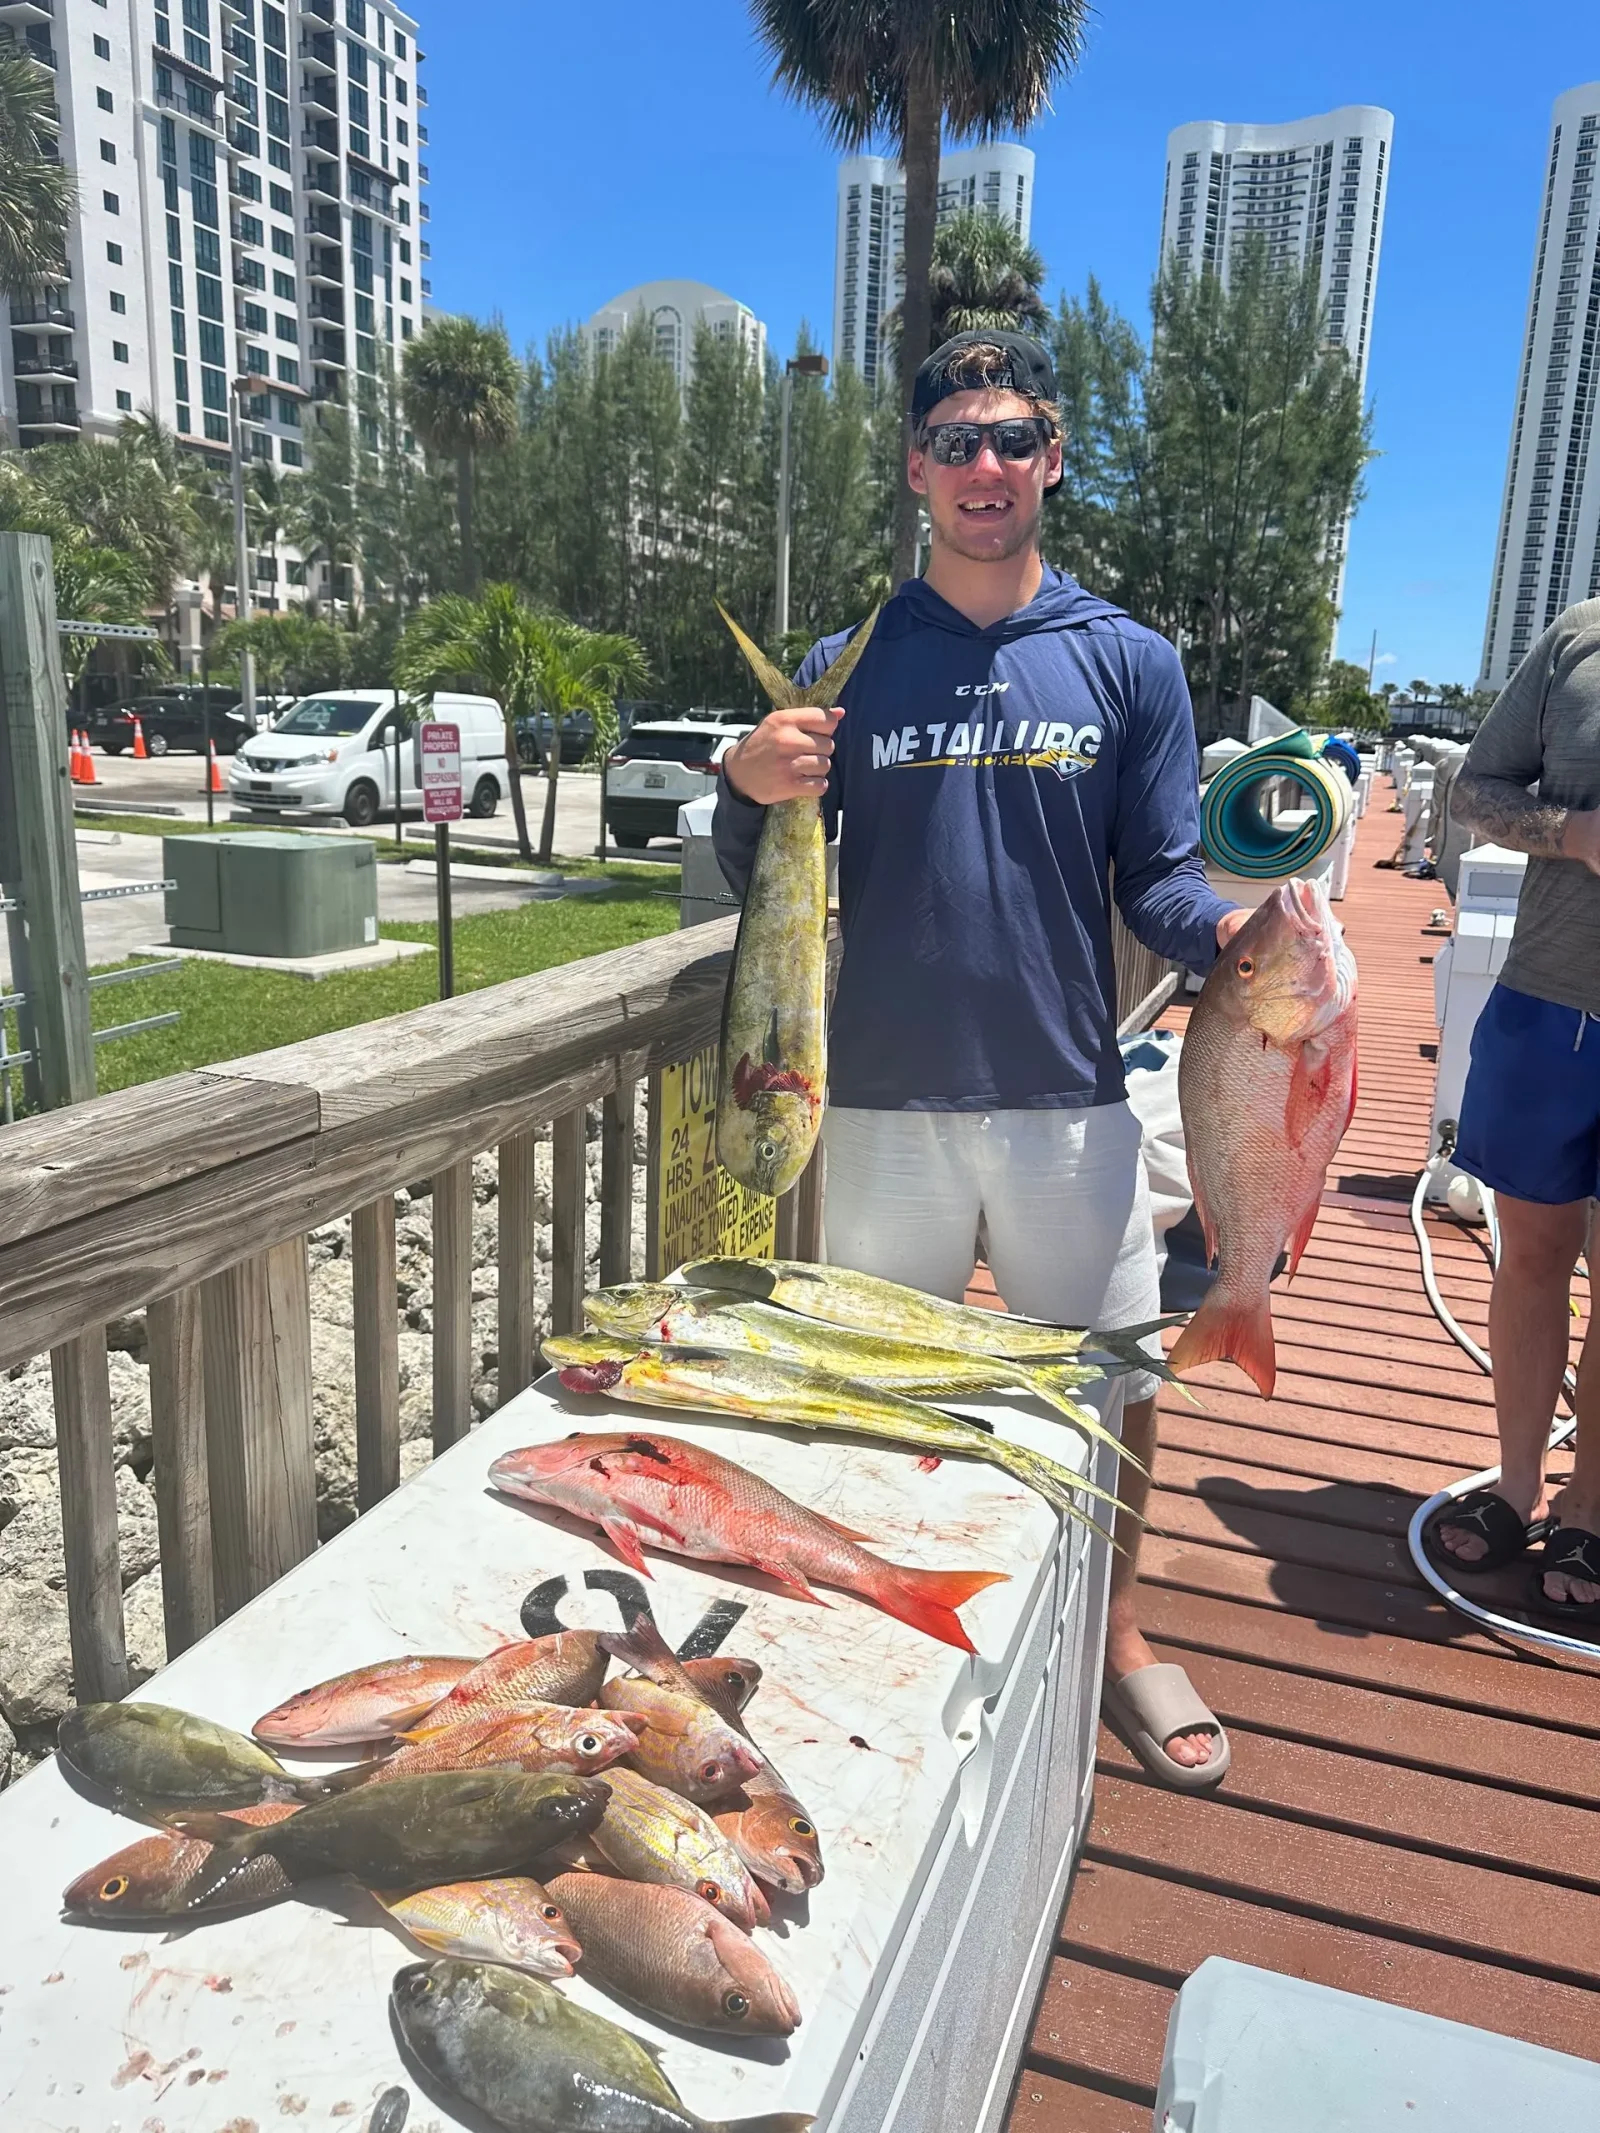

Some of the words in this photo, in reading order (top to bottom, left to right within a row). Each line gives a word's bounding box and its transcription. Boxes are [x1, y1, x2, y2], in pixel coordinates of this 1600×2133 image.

[955, 682, 1009, 696] CCM
[423, 741, 458, 751] PROPERTY
[427, 731, 454, 741] PRIVATE
[872, 720, 1102, 769] METALLURG
[671, 1123, 689, 1161] 24
[666, 1156, 692, 1198] HRS
[665, 1168, 736, 1239] UNAUTHORIZED
[664, 1231, 688, 1276] WILL
[691, 1218, 704, 1256] BE
[708, 1194, 739, 1243] TOWED
[740, 1199, 774, 1253] EXPENSE
